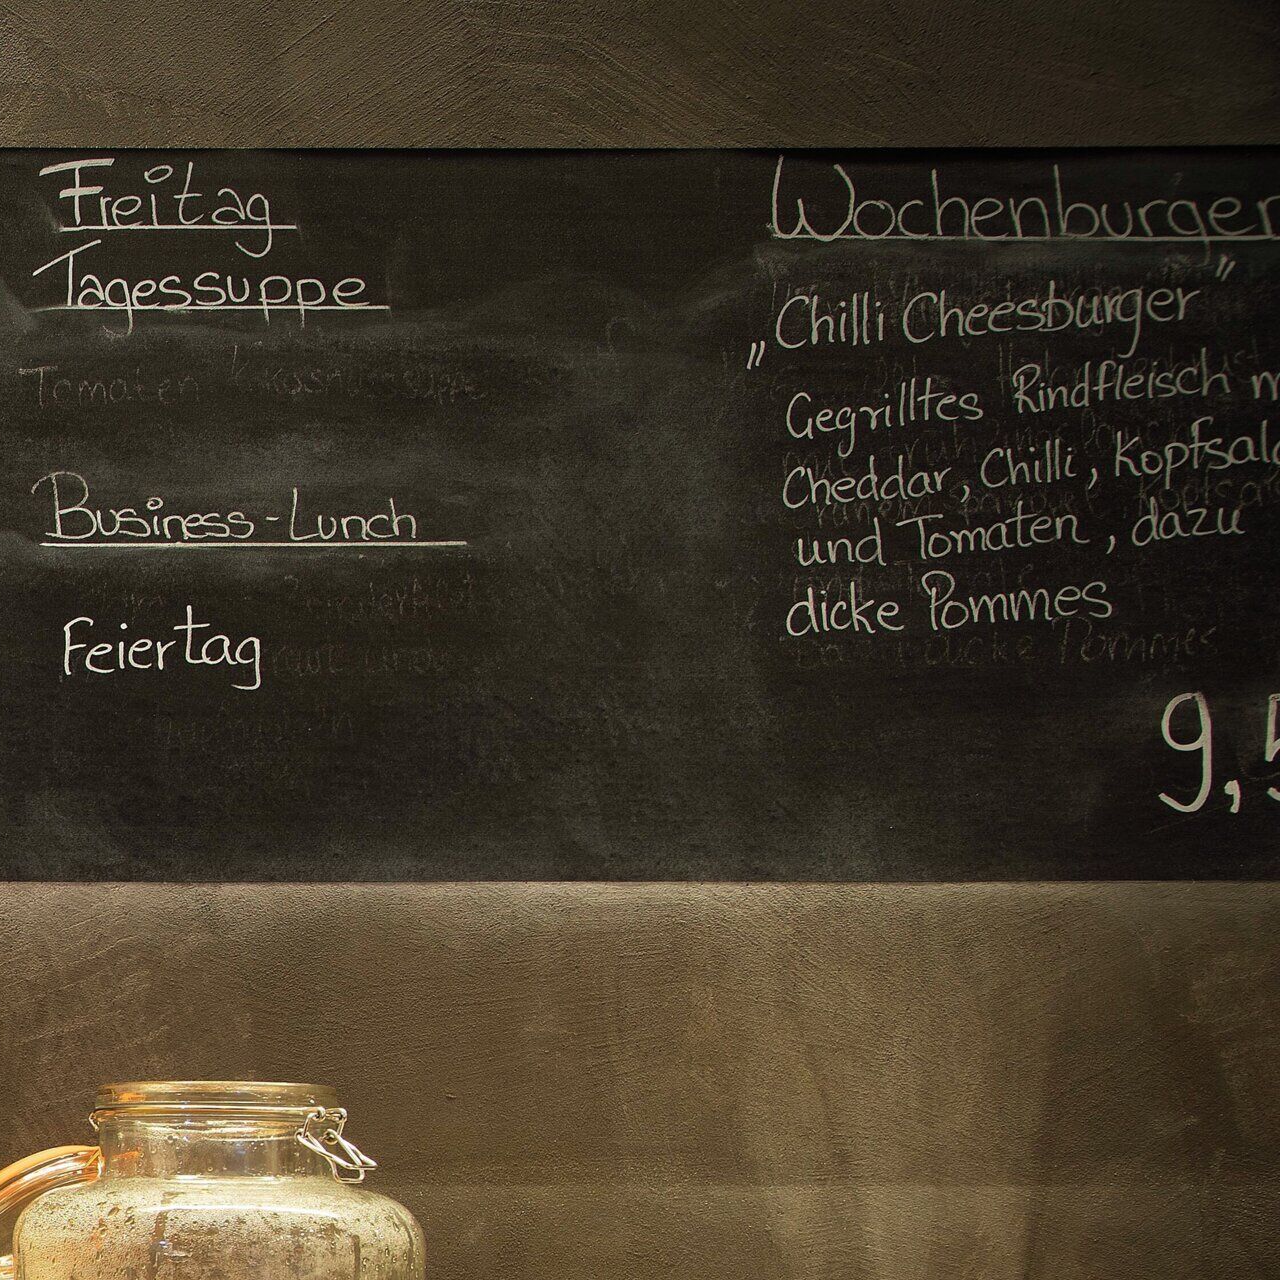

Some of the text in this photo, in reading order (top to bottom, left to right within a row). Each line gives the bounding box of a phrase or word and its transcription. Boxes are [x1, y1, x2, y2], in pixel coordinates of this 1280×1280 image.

[39, 157, 272, 257] Freitag
[771, 154, 1280, 265] Wochenburger
[33, 239, 371, 337] Tagessuppe
[785, 346, 1232, 458] Gegrilltes Rindfleisch
[31, 471, 418, 542] Business-Lunch
[798, 517, 888, 569] und
[1130, 497, 1246, 547] dazu
[62, 603, 263, 691] Feiertag
[785, 568, 1114, 638] dicke Pommes
